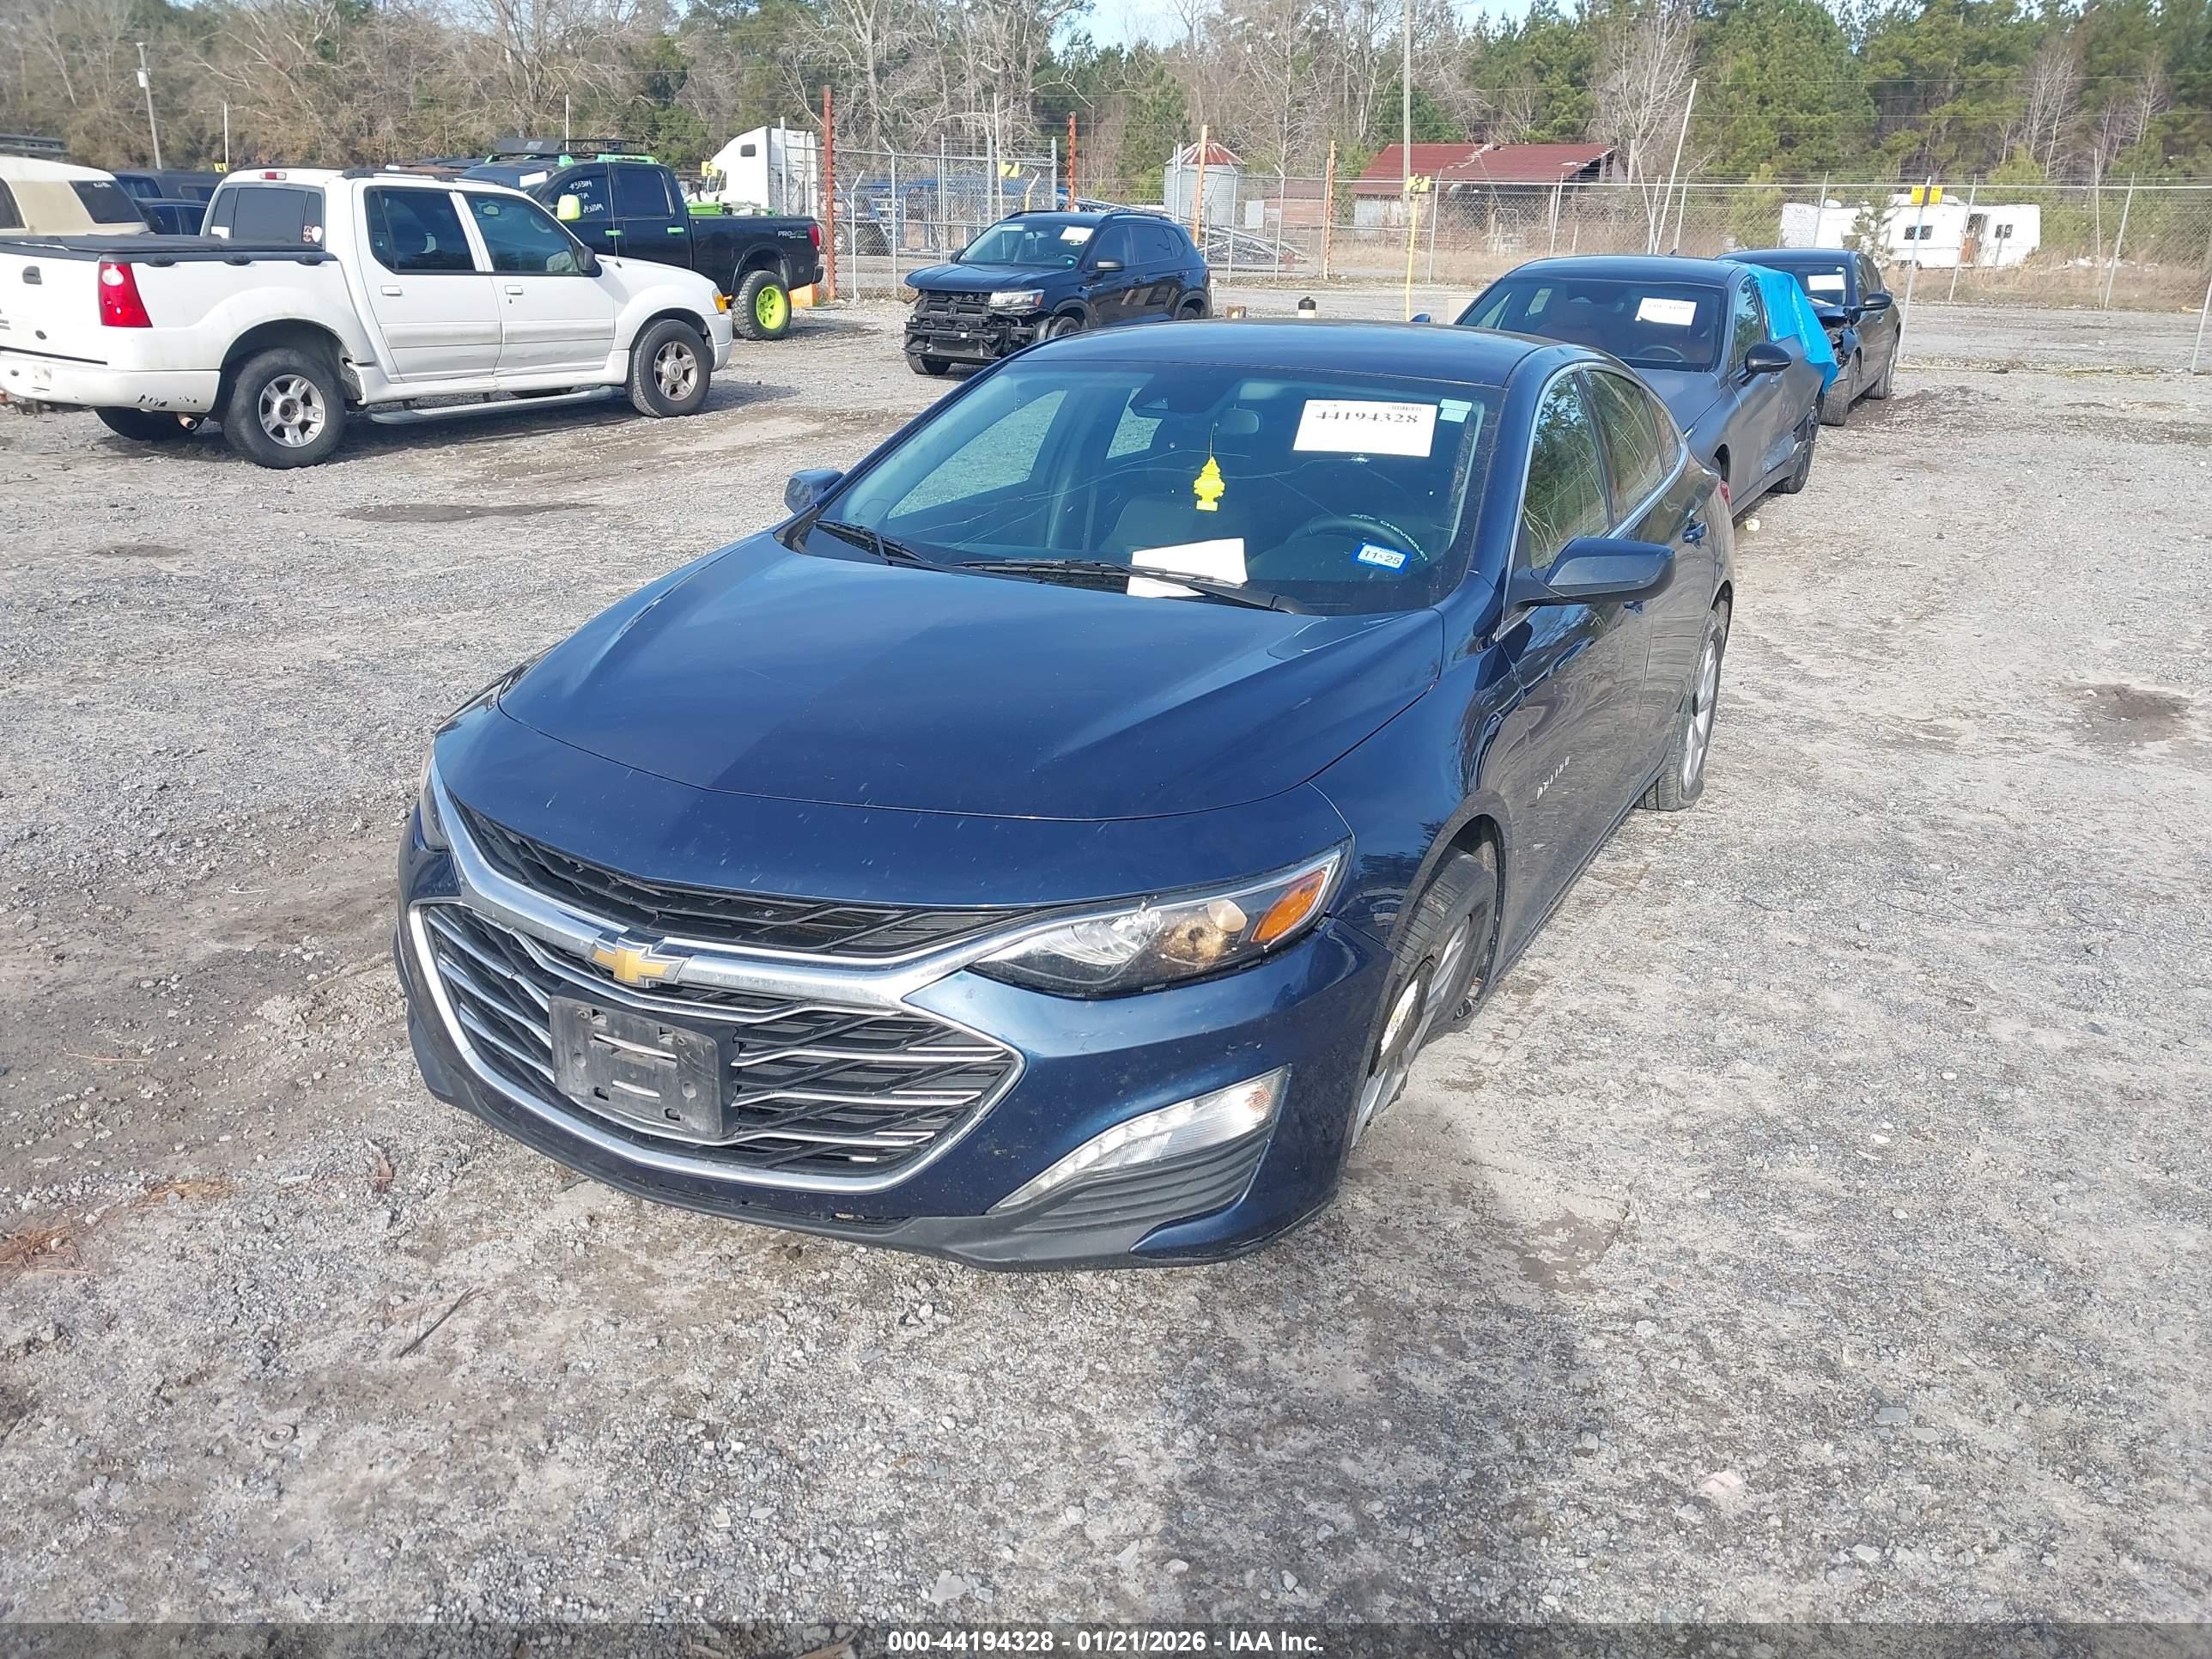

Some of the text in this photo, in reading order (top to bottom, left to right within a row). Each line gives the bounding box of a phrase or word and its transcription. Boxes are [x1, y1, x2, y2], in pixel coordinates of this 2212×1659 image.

[706, 162, 714, 176] 6
[1409, 177, 1425, 192] 8
[1315, 410, 1419, 424] 44194328
